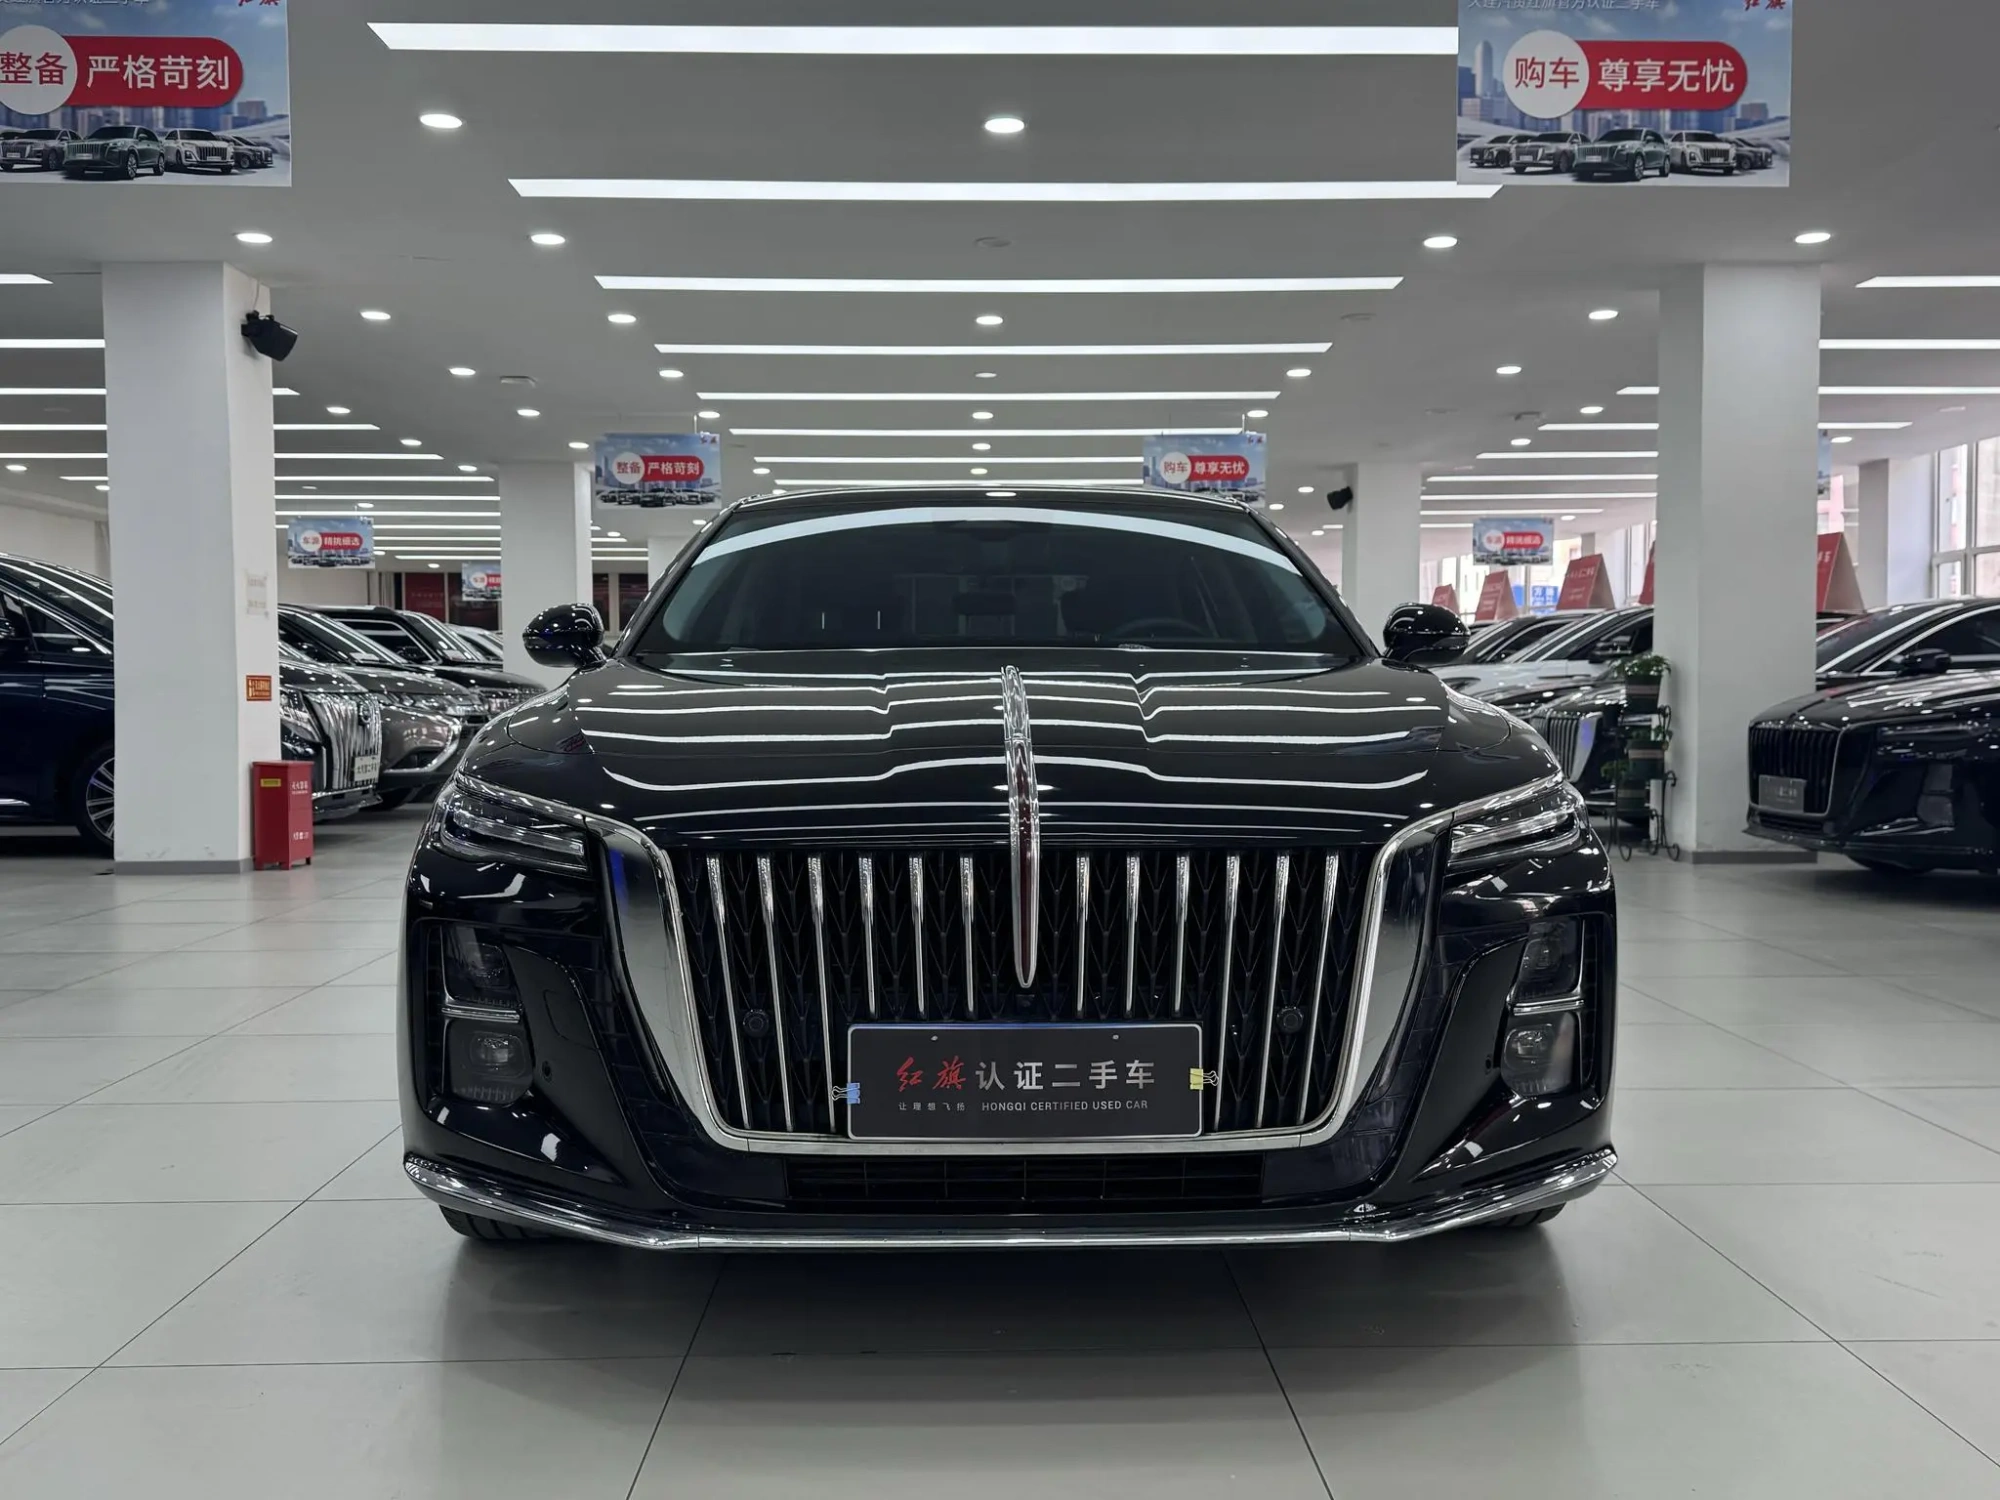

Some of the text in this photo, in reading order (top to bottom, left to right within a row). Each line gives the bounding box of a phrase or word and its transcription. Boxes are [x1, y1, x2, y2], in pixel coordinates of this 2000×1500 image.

[0, 52, 230, 91] 整备 严格苛刻
[1514, 57, 1735, 93] 购车 尊享无忧
[647, 461, 700, 475] 严格苛刻
[1194, 461, 1246, 475] 尊享无忧
[981, 1099, 1149, 1112] HONGQI CERTIFIED USED CAR
